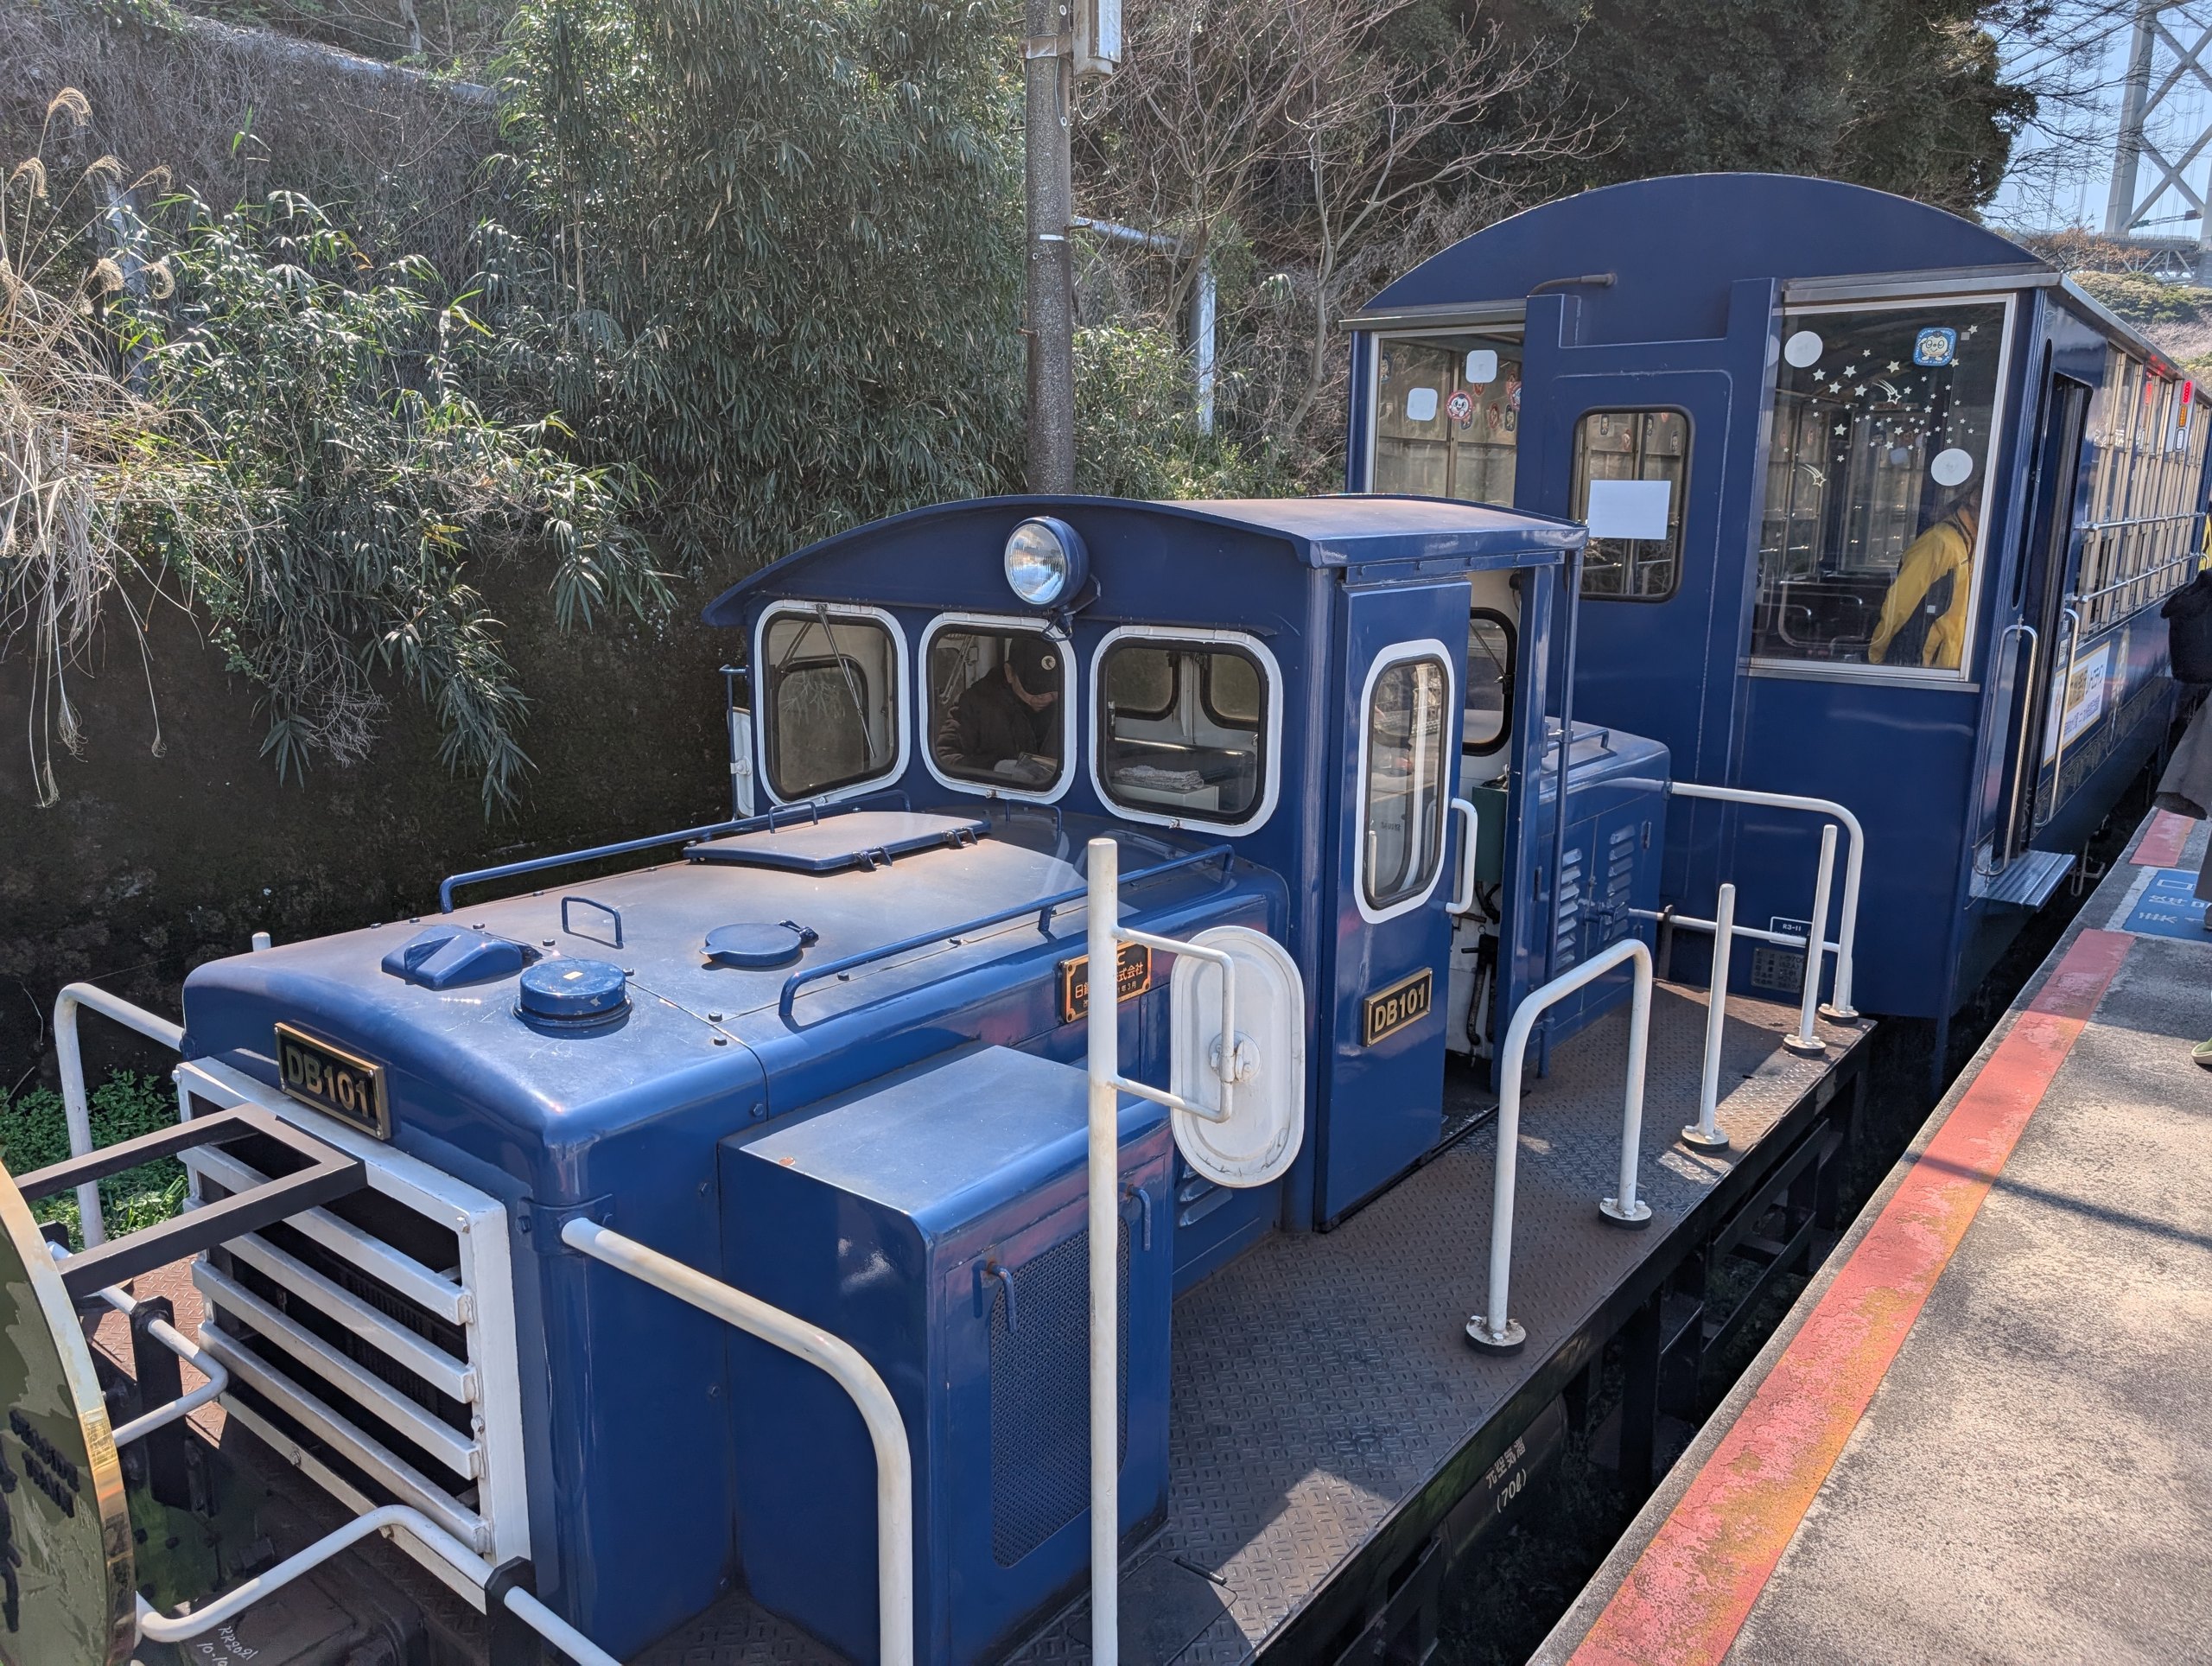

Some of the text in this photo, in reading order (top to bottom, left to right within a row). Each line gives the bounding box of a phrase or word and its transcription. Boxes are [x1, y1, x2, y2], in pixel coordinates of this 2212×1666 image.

[1117, 961, 1143, 982] 式会社
[1374, 983, 1425, 1032] DB101
[286, 1044, 369, 1119] DB101
